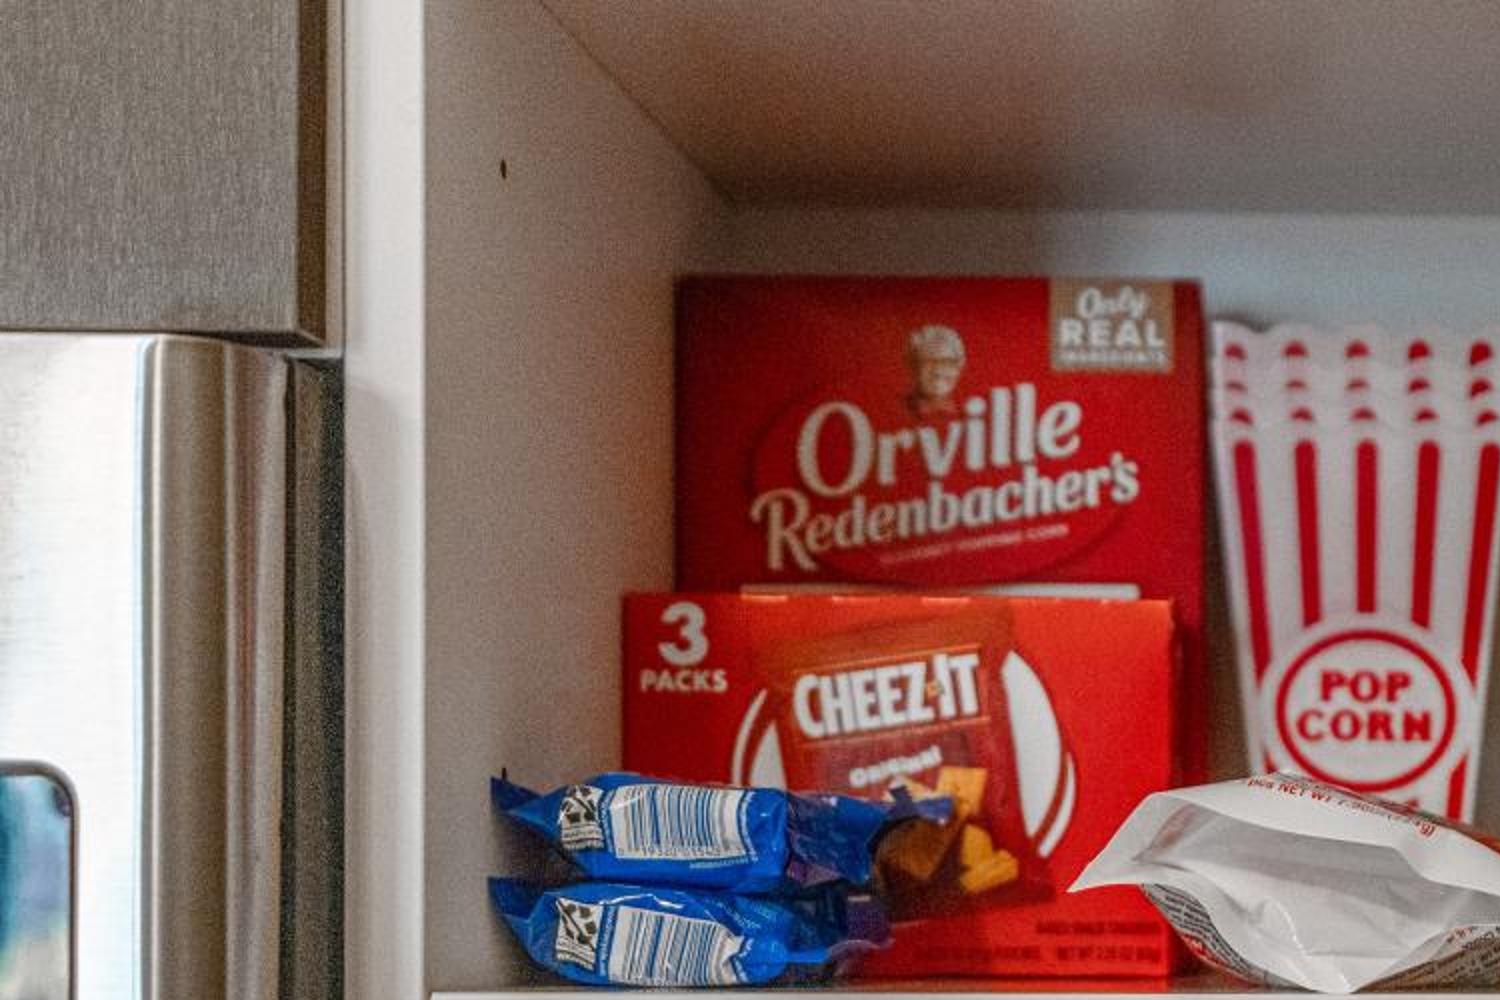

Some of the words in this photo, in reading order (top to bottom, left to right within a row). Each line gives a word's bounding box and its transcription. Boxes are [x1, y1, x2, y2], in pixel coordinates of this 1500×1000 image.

[1059, 319, 1165, 347] REAL
[797, 382, 1083, 495] Orville
[751, 452, 1139, 571] Redenbacher's
[657, 603, 710, 666] 3
[641, 669, 728, 693] PACKS
[1320, 669, 1413, 702] POP
[1297, 711, 1434, 743] CORN
